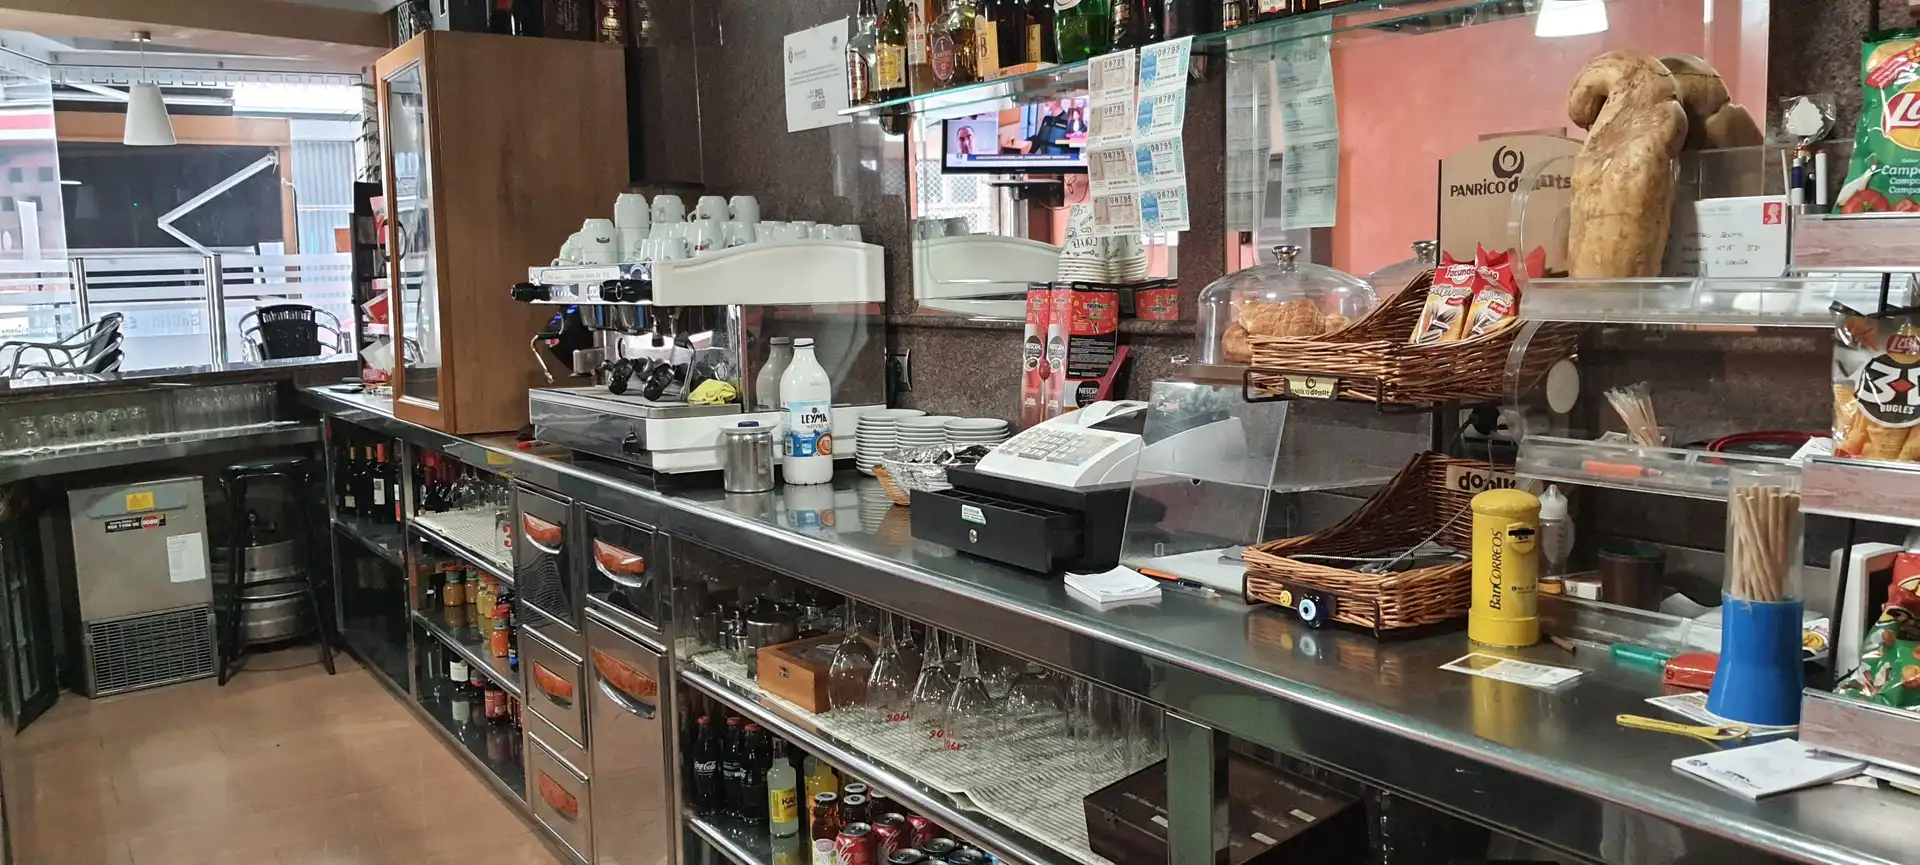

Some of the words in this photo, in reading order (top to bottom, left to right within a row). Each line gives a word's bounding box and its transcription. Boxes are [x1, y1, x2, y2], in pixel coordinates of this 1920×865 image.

[1158, 45, 1180, 57] 08795
[1104, 57, 1125, 68] 08795
[1154, 93, 1176, 104] 08795
[1104, 104, 1125, 116] 08795
[1889, 93, 1920, 127] La
[1150, 142, 1172, 152] 08795
[1104, 150, 1125, 160] 08795
[1881, 164, 1920, 178] Camp
[1110, 196, 1132, 204] 08795
[1157, 190, 1178, 199] 08795
[1880, 404, 1915, 415] BUGLES
[802, 413, 828, 424] LEYMA
